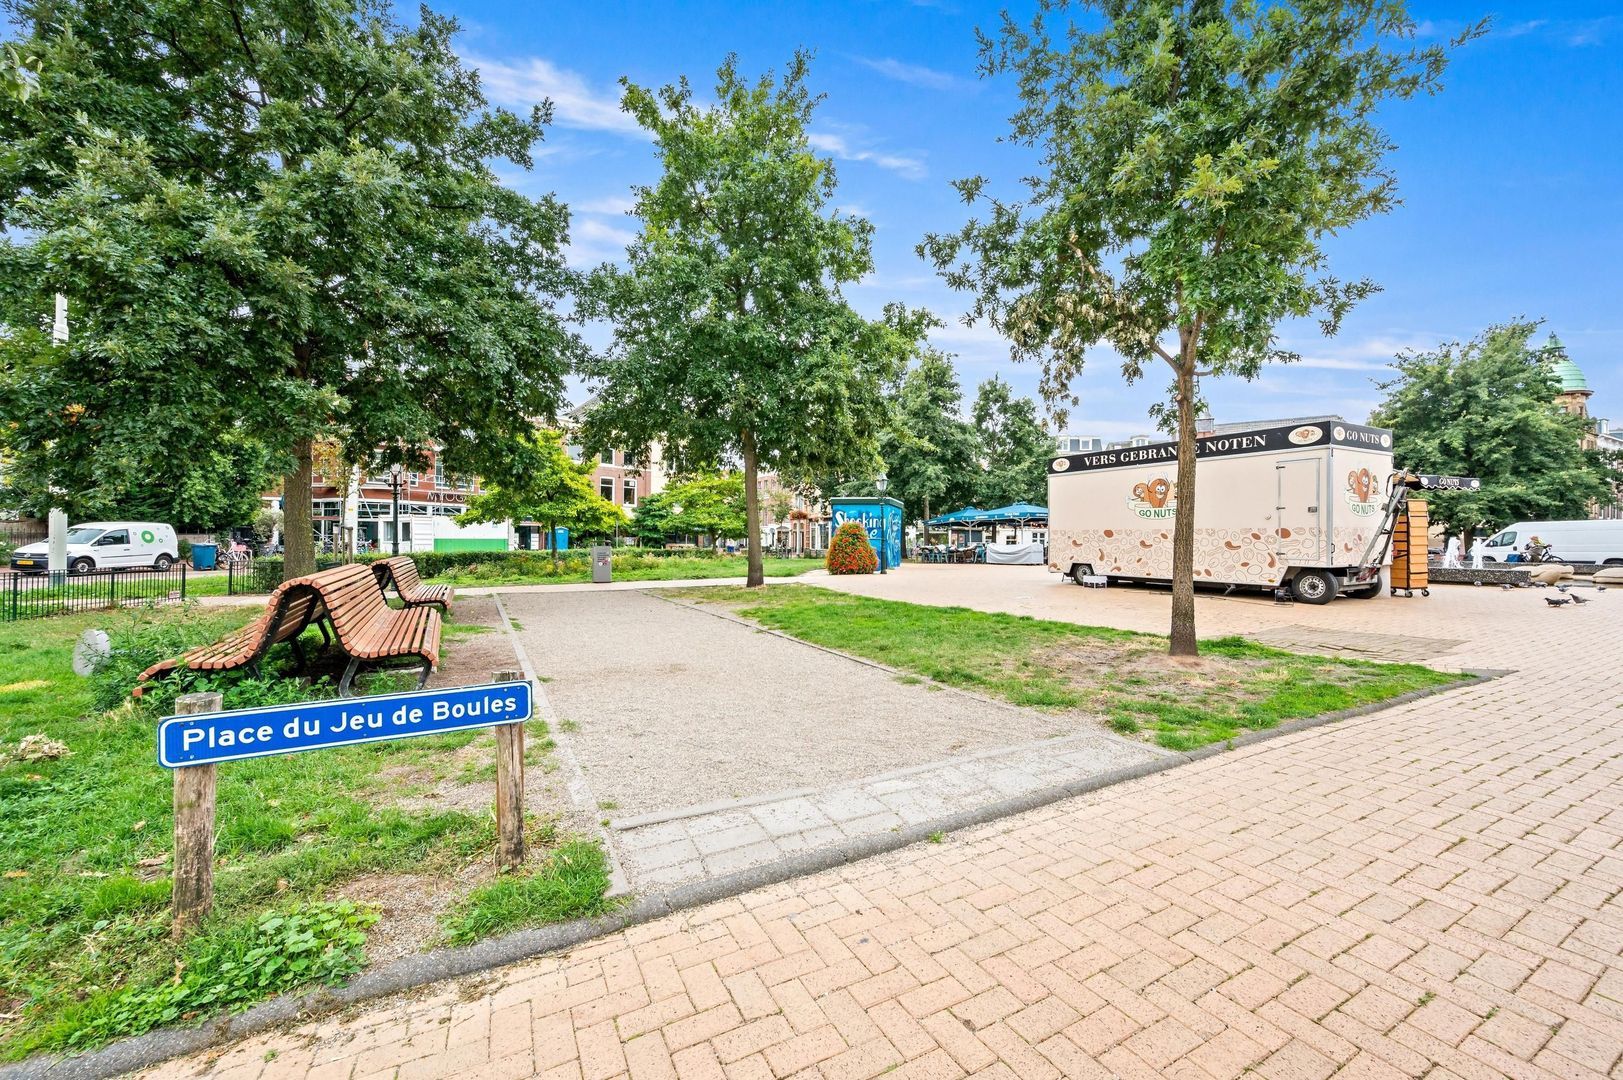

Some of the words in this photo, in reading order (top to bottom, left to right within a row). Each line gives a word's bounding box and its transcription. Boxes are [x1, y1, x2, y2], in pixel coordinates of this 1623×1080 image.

[1346, 430, 1358, 441] GO
[1359, 432, 1380, 445] NUTS
[1083, 453, 1117, 467] VERS
[1120, 443, 1200, 463] GEBRANE
[1205, 434, 1267, 453] NOTEN
[1138, 509, 1152, 518] GO
[1351, 503, 1361, 514] GO
[1360, 503, 1376, 515] NUTS
[182, 725, 272, 752] Place
[283, 717, 320, 738] du
[330, 711, 383, 734] Jeu
[391, 704, 423, 726] de
[433, 695, 517, 721] Boules
